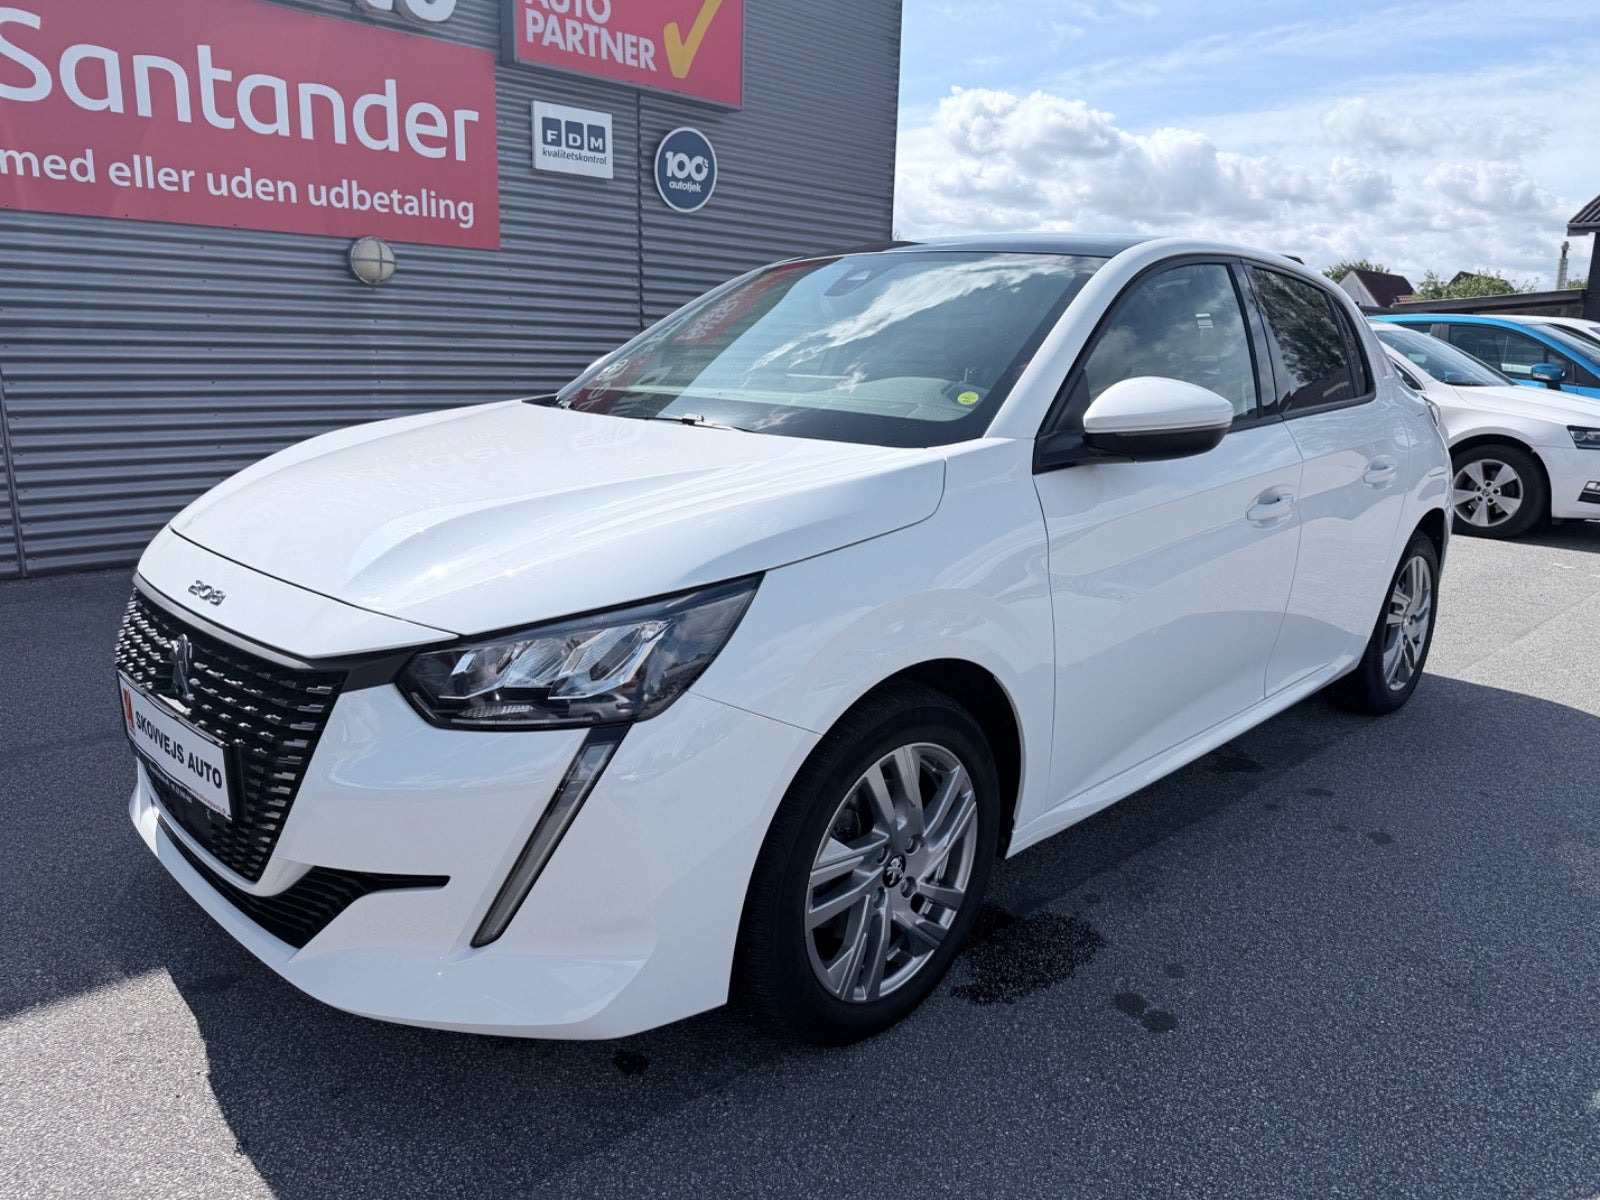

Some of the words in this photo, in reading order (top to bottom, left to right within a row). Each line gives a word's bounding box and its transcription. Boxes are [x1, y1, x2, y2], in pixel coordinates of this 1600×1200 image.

[525, 8, 657, 72] PARTNER
[0, 7, 479, 162] Santander
[542, 147, 608, 165] kvalitetskontrol
[546, 130, 604, 151] FDM
[0, 149, 96, 183] med
[108, 154, 195, 193] eller
[206, 168, 297, 203] uden
[308, 179, 475, 228] udbetaling
[187, 752, 223, 789] AUTO
